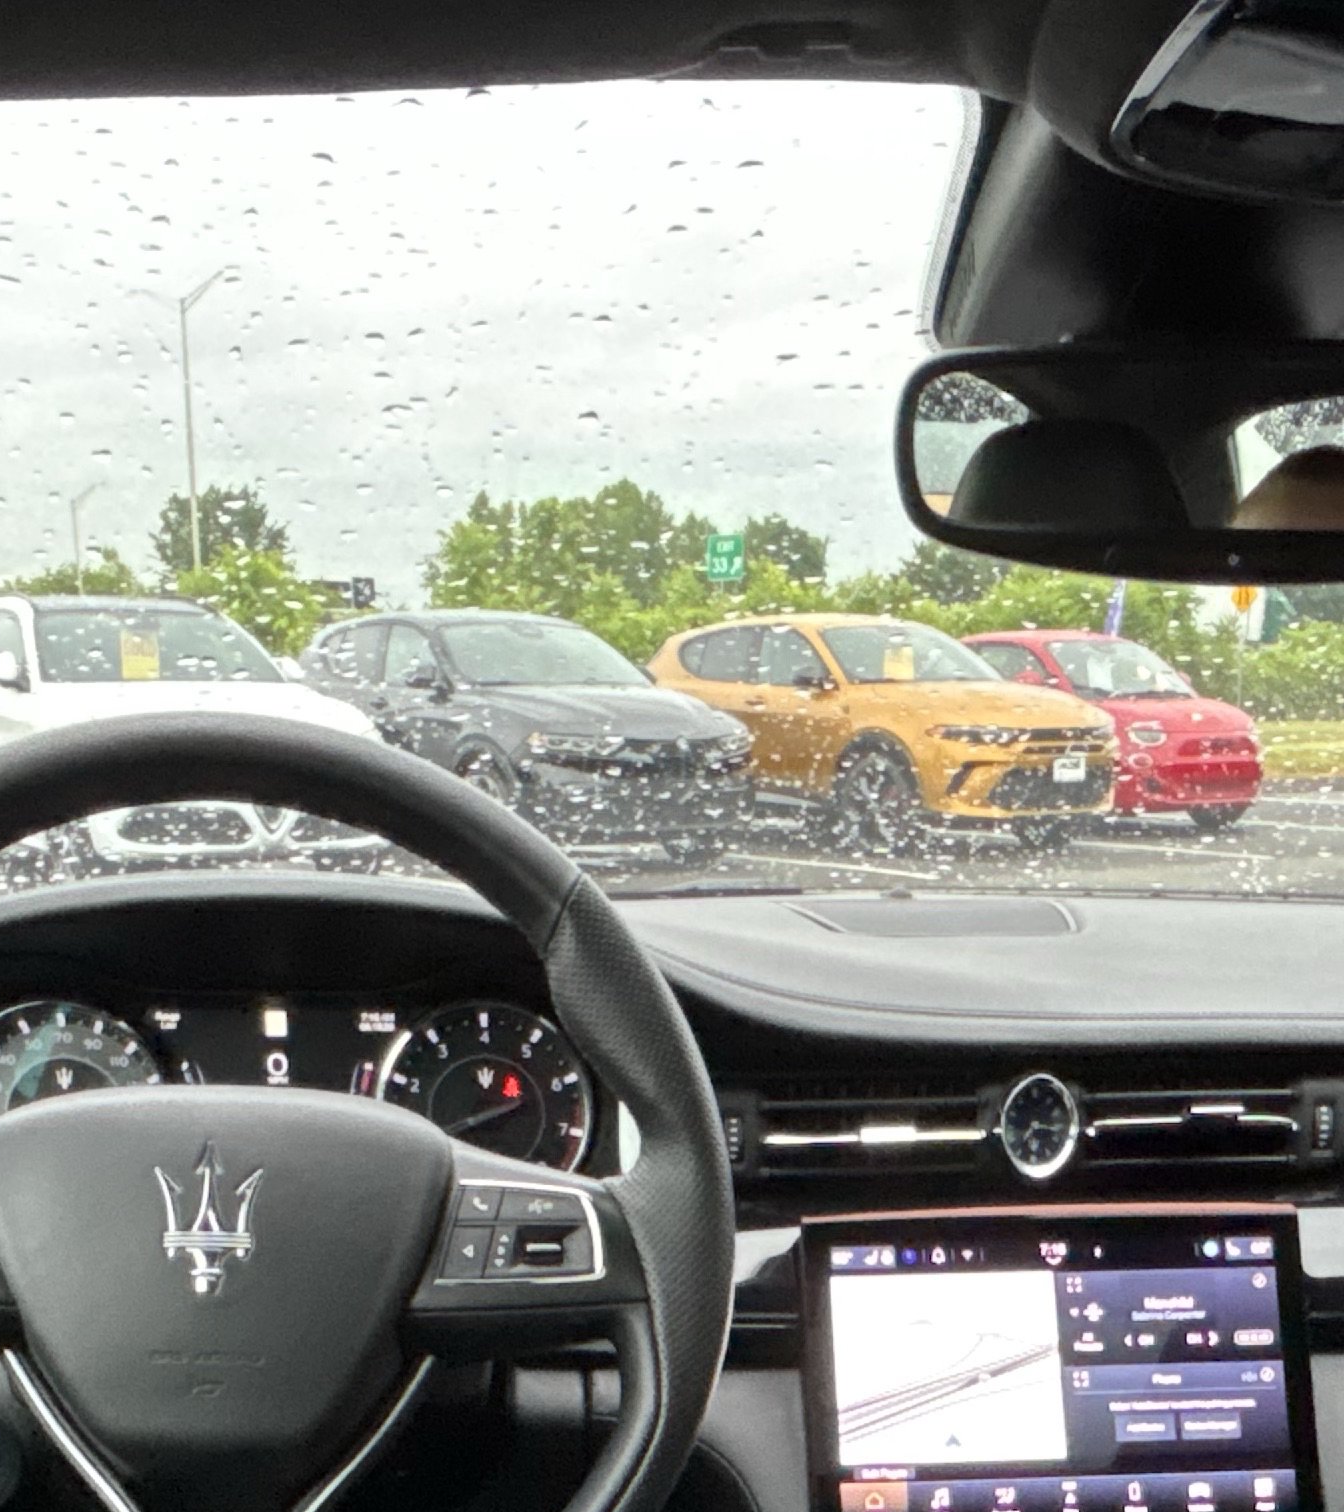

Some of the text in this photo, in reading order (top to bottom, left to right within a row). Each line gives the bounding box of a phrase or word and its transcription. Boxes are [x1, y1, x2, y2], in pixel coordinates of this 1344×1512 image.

[712, 556, 728, 574] 33
[54, 1032, 73, 1044] 70
[83, 1038, 103, 1051] 90
[479, 1031, 491, 1044] 4
[438, 1044, 449, 1059] 3
[521, 1043, 532, 1059] 5
[109, 1055, 130, 1068] 110
[409, 1078, 420, 1094] 2
[551, 1077, 563, 1092] 6
[558, 1122, 569, 1135] 7
